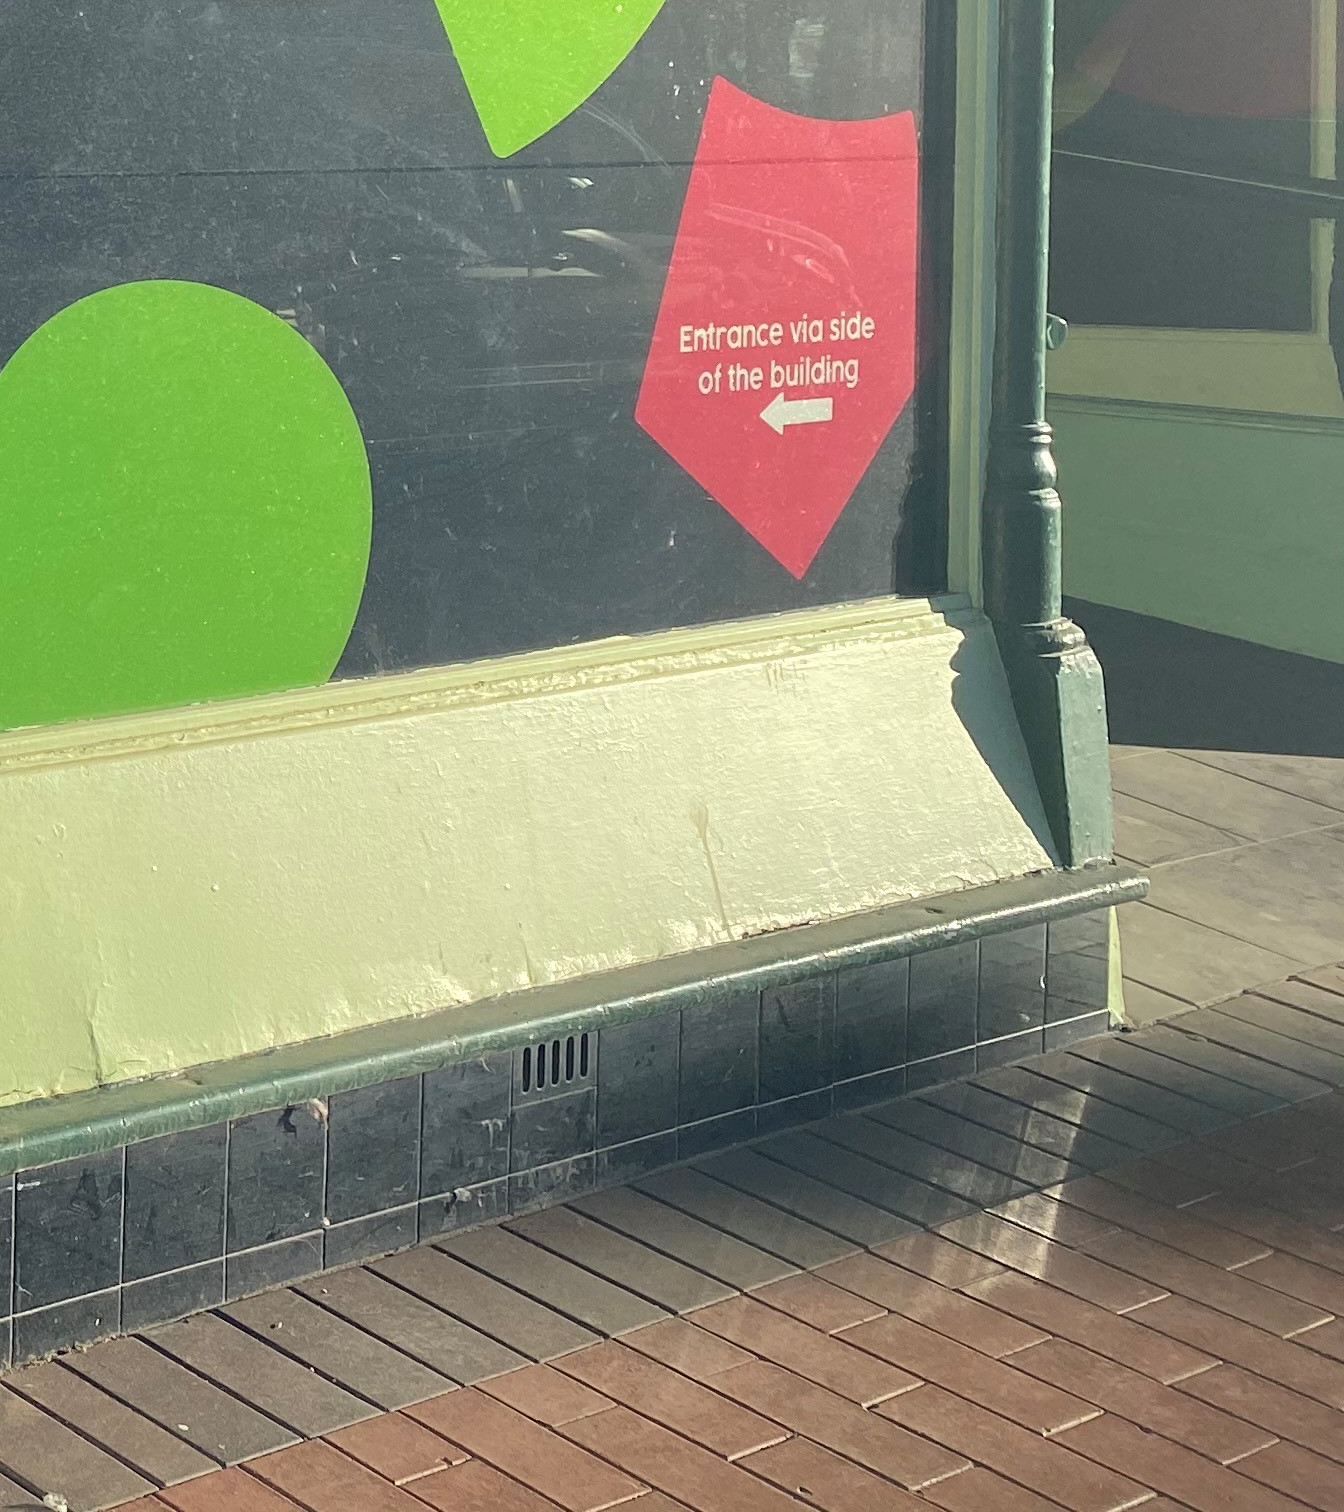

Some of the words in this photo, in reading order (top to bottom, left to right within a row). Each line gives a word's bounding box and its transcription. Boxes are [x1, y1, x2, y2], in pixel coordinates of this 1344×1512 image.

[679, 322, 784, 353] Entrance
[789, 313, 823, 344] via
[829, 311, 876, 341] side
[698, 362, 722, 395] of
[727, 362, 764, 392] the
[770, 354, 860, 389] building
